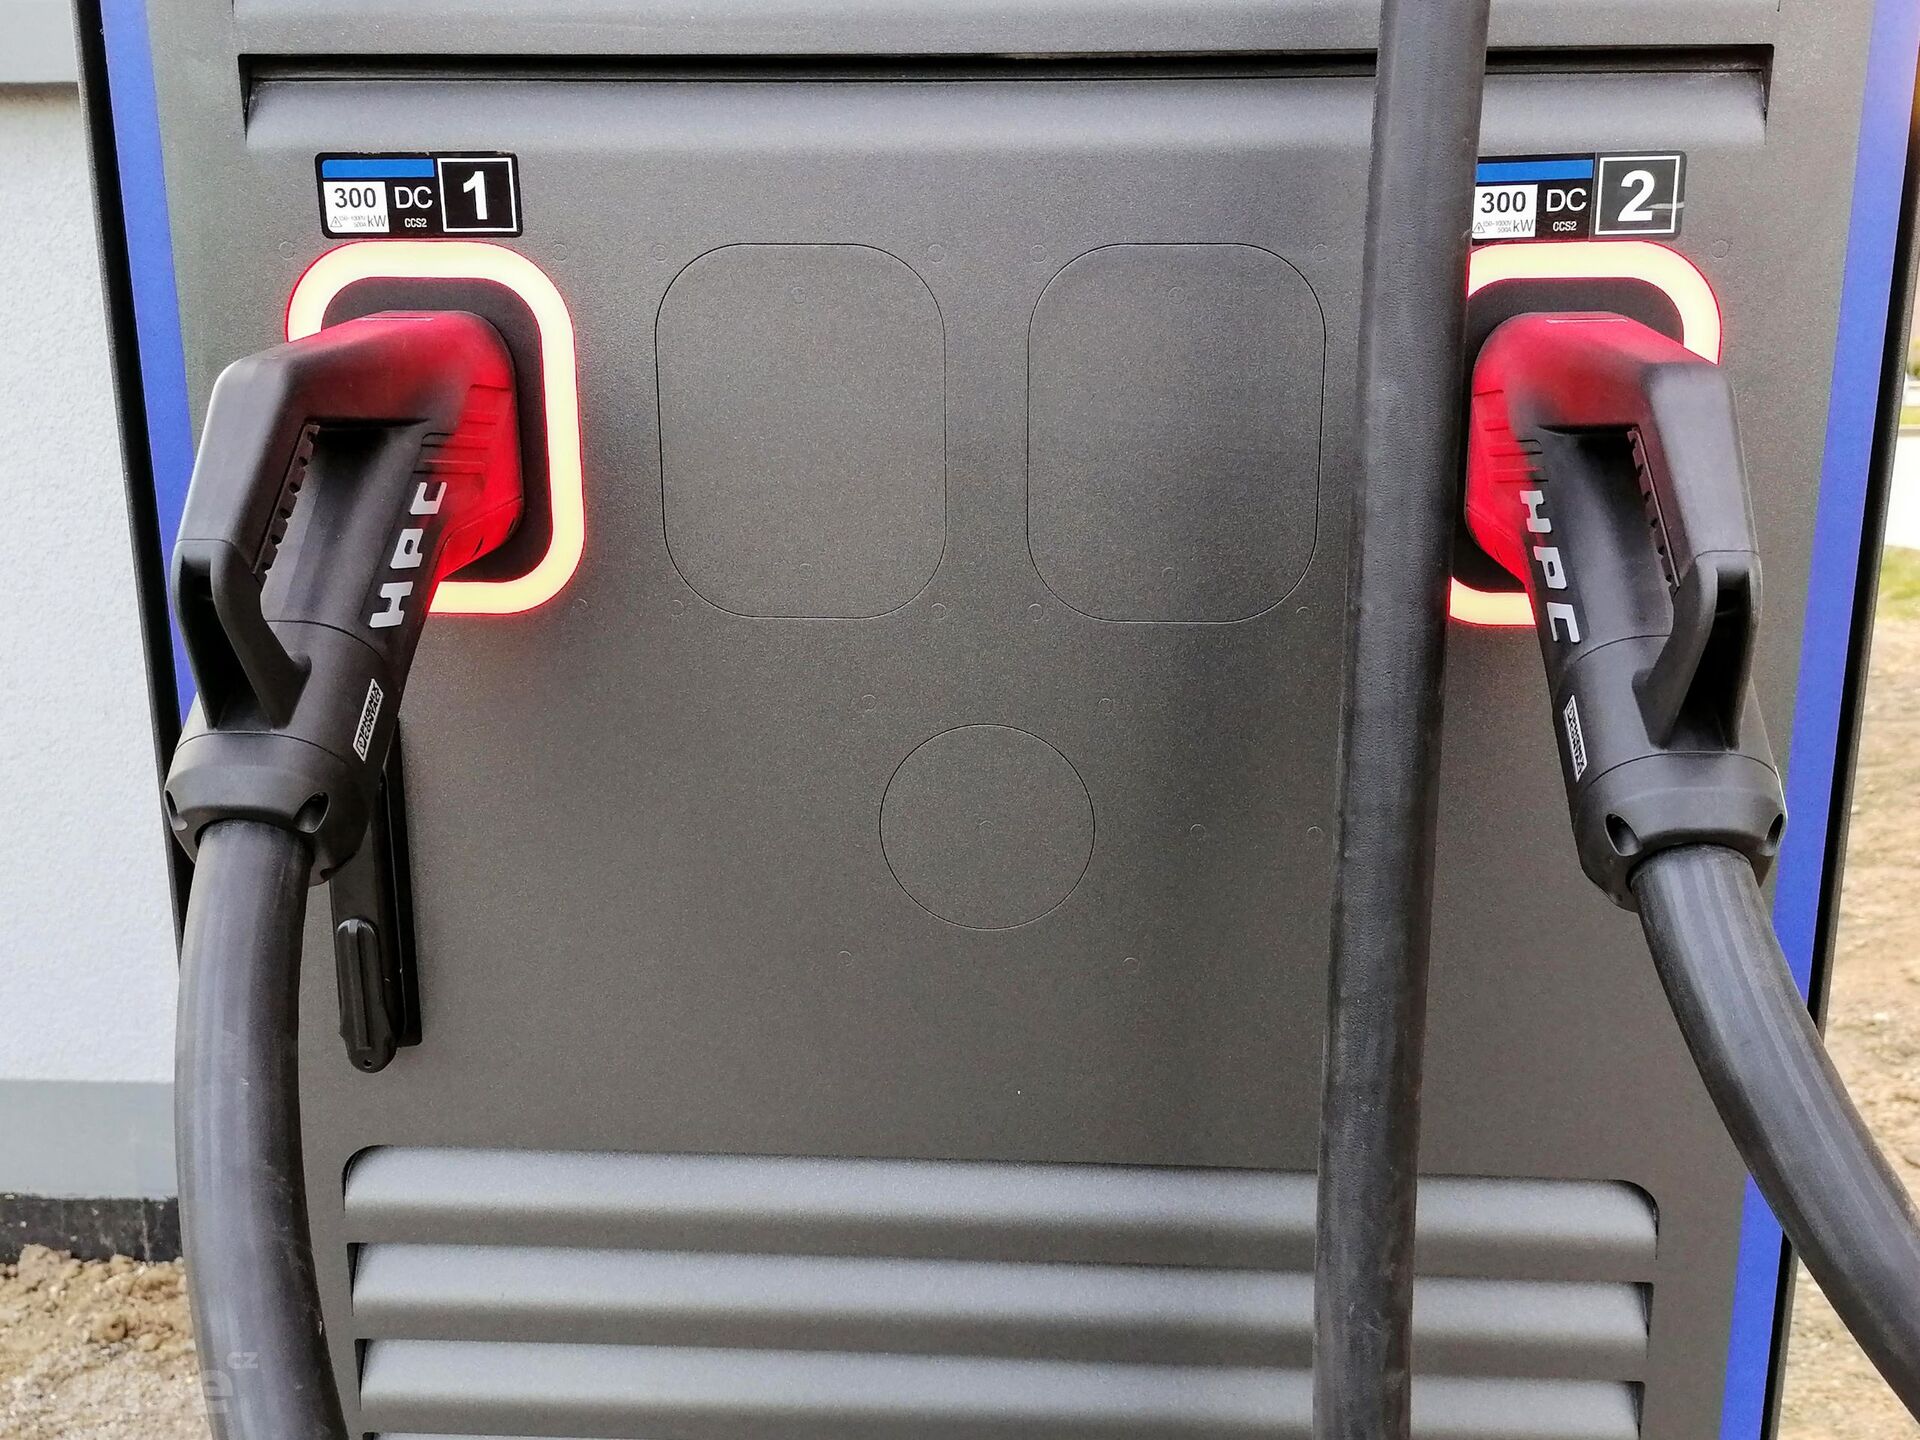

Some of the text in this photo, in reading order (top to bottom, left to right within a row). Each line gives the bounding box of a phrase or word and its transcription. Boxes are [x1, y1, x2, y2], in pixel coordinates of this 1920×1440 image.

[335, 187, 377, 209] 300
[394, 186, 433, 208] DC
[462, 170, 488, 220] 1
[1480, 191, 1527, 214] 300
[1546, 188, 1587, 212] DC
[1617, 169, 1655, 222] 2
[367, 214, 387, 227] kW
[404, 217, 428, 228] CCS2
[1513, 219, 1534, 233] kW
[1552, 221, 1577, 232] CCS2
[369, 481, 447, 628] HPC
[1519, 490, 1581, 644] HPC
